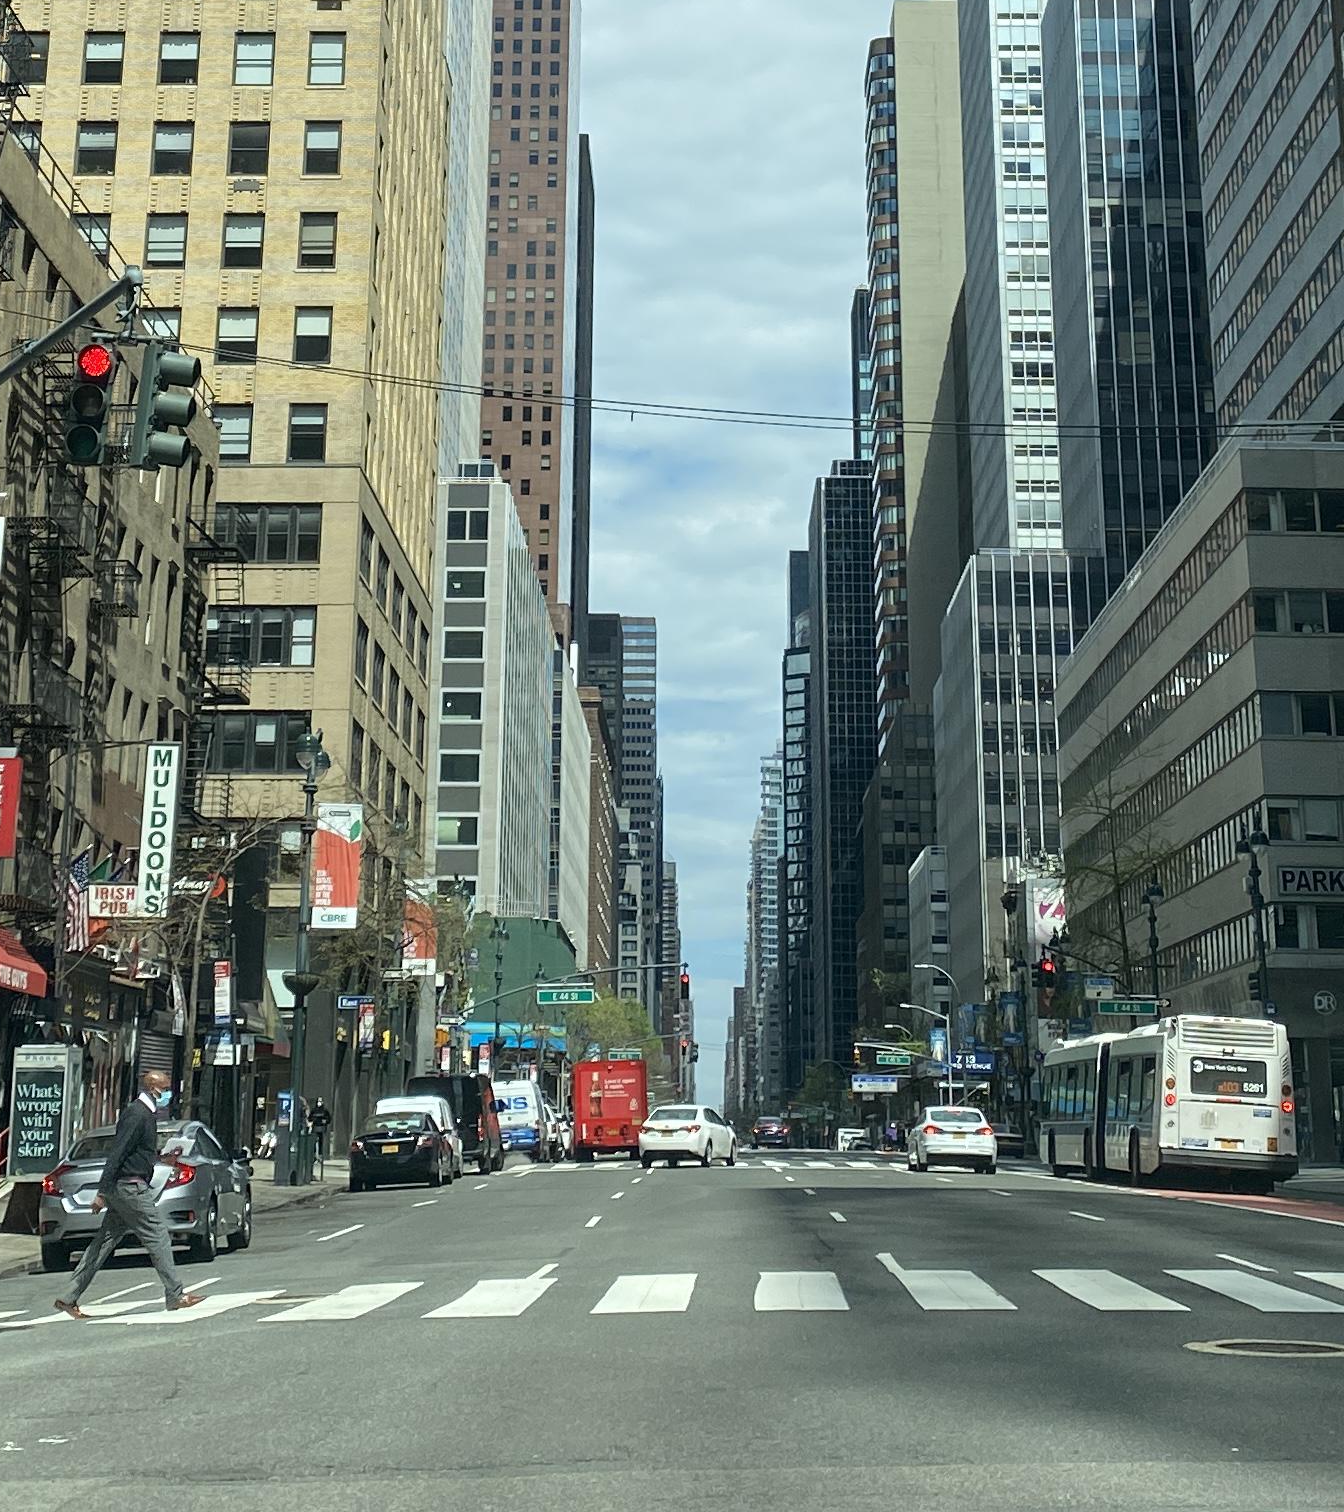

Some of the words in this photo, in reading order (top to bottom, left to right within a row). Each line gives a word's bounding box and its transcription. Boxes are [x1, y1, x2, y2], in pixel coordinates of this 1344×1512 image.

[143, 749, 173, 915] MULDOON'S
[94, 887, 135, 901] IRISH
[99, 901, 129, 915] PUB
[320, 913, 348, 923] CBRE
[17, 1083, 61, 1099] What's
[16, 1100, 62, 1116] wrong
[22, 1112, 52, 1128] with
[20, 1130, 53, 1145] your
[18, 1142, 55, 1158] skin?
